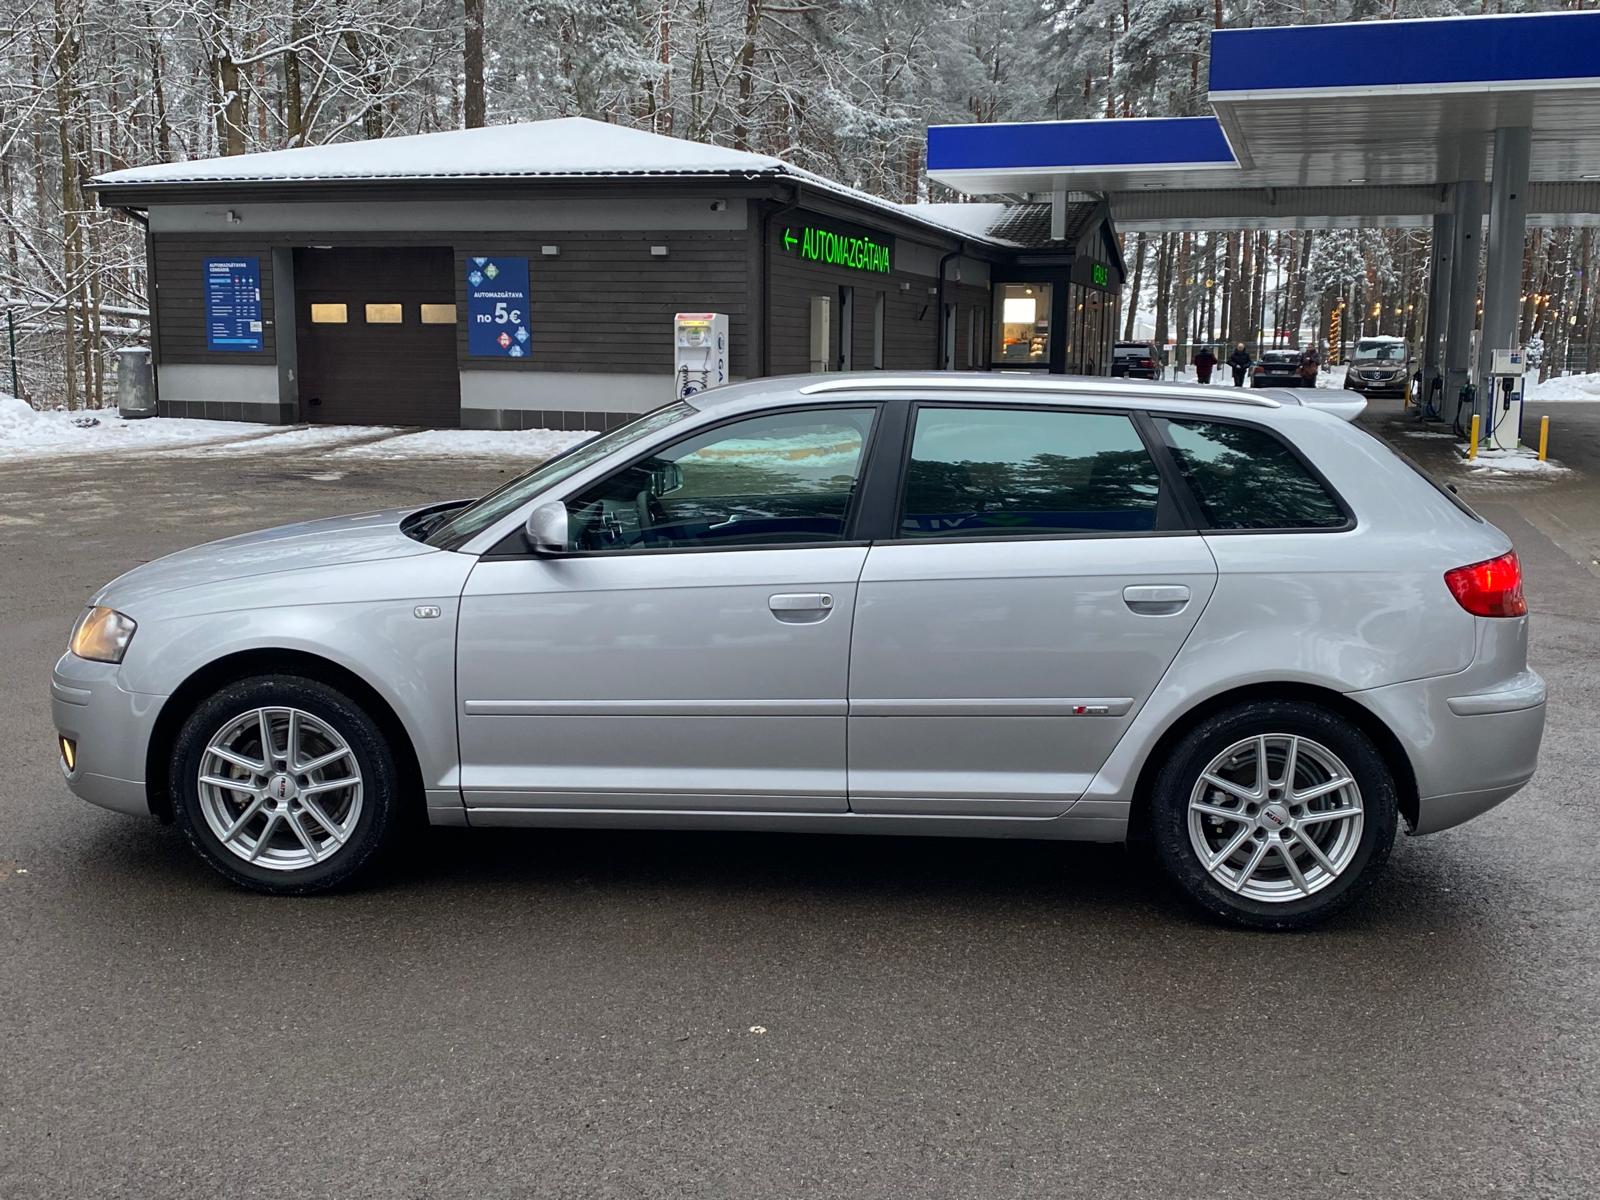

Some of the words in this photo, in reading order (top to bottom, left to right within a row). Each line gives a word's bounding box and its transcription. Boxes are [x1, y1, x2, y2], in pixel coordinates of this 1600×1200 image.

[802, 227, 890, 273] AUTOMAZGĀTAVA
[477, 315, 492, 323] no
[495, 303, 521, 324] 5€
